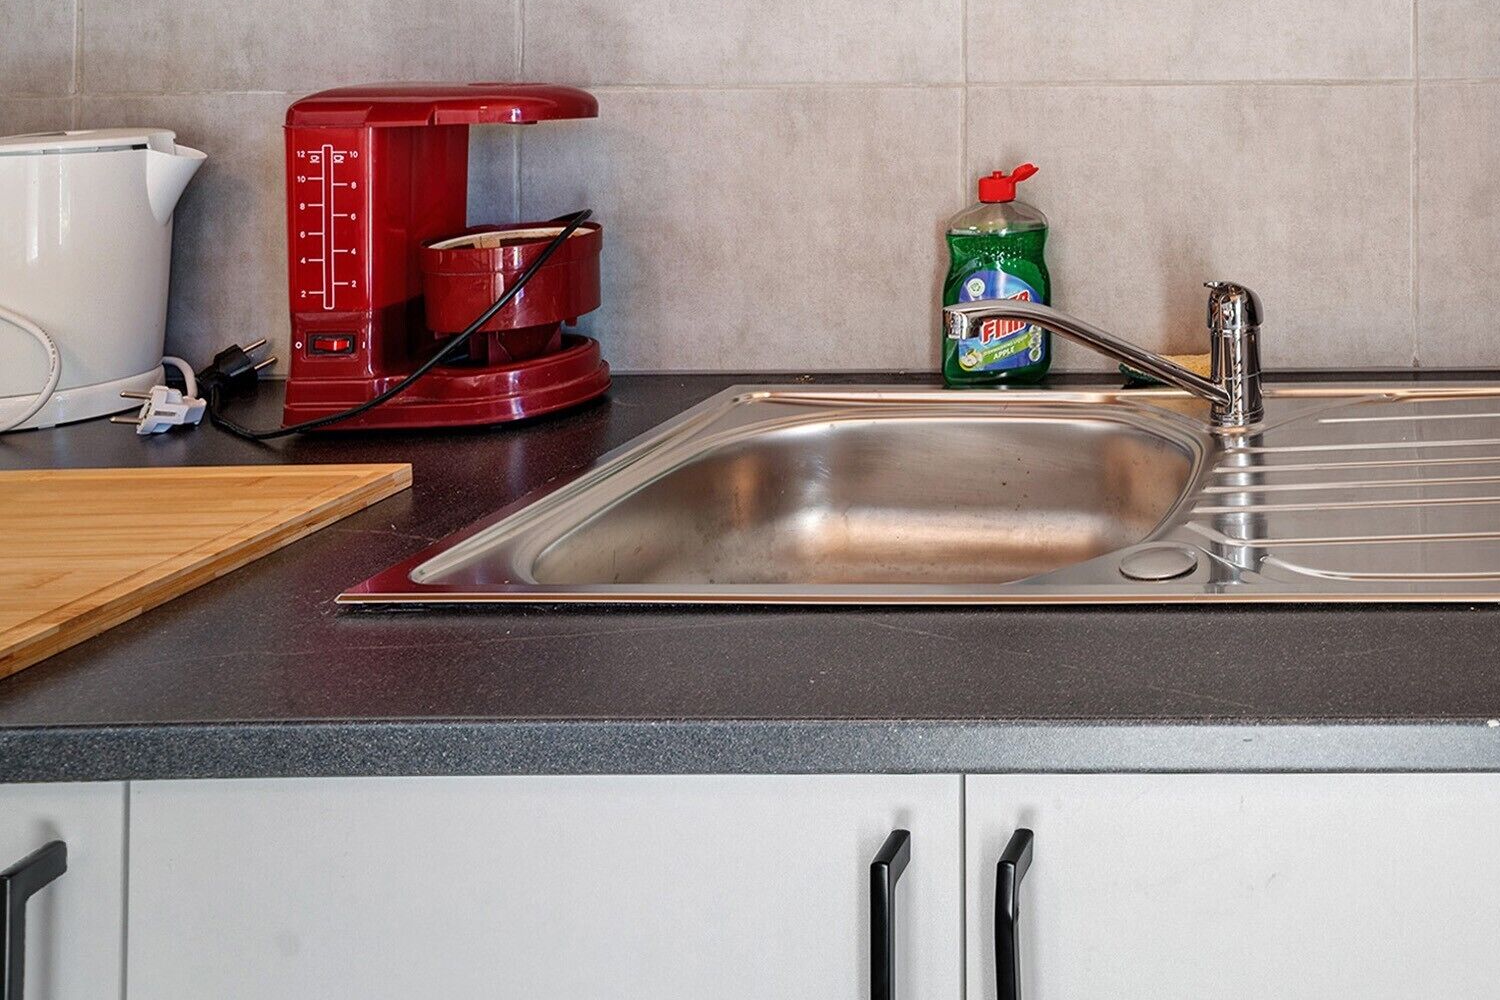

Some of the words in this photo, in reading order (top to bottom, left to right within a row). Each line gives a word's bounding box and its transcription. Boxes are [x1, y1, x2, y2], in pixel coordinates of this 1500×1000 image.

[296, 150, 306, 158] 12
[349, 150, 359, 159] 10
[296, 175, 307, 183] 10
[350, 181, 357, 190] 8
[299, 202, 306, 211] 8
[350, 212, 357, 221] 6
[299, 230, 306, 239] 6
[300, 257, 306, 265] 4
[351, 280, 357, 288] 2
[300, 290, 307, 298] 2
